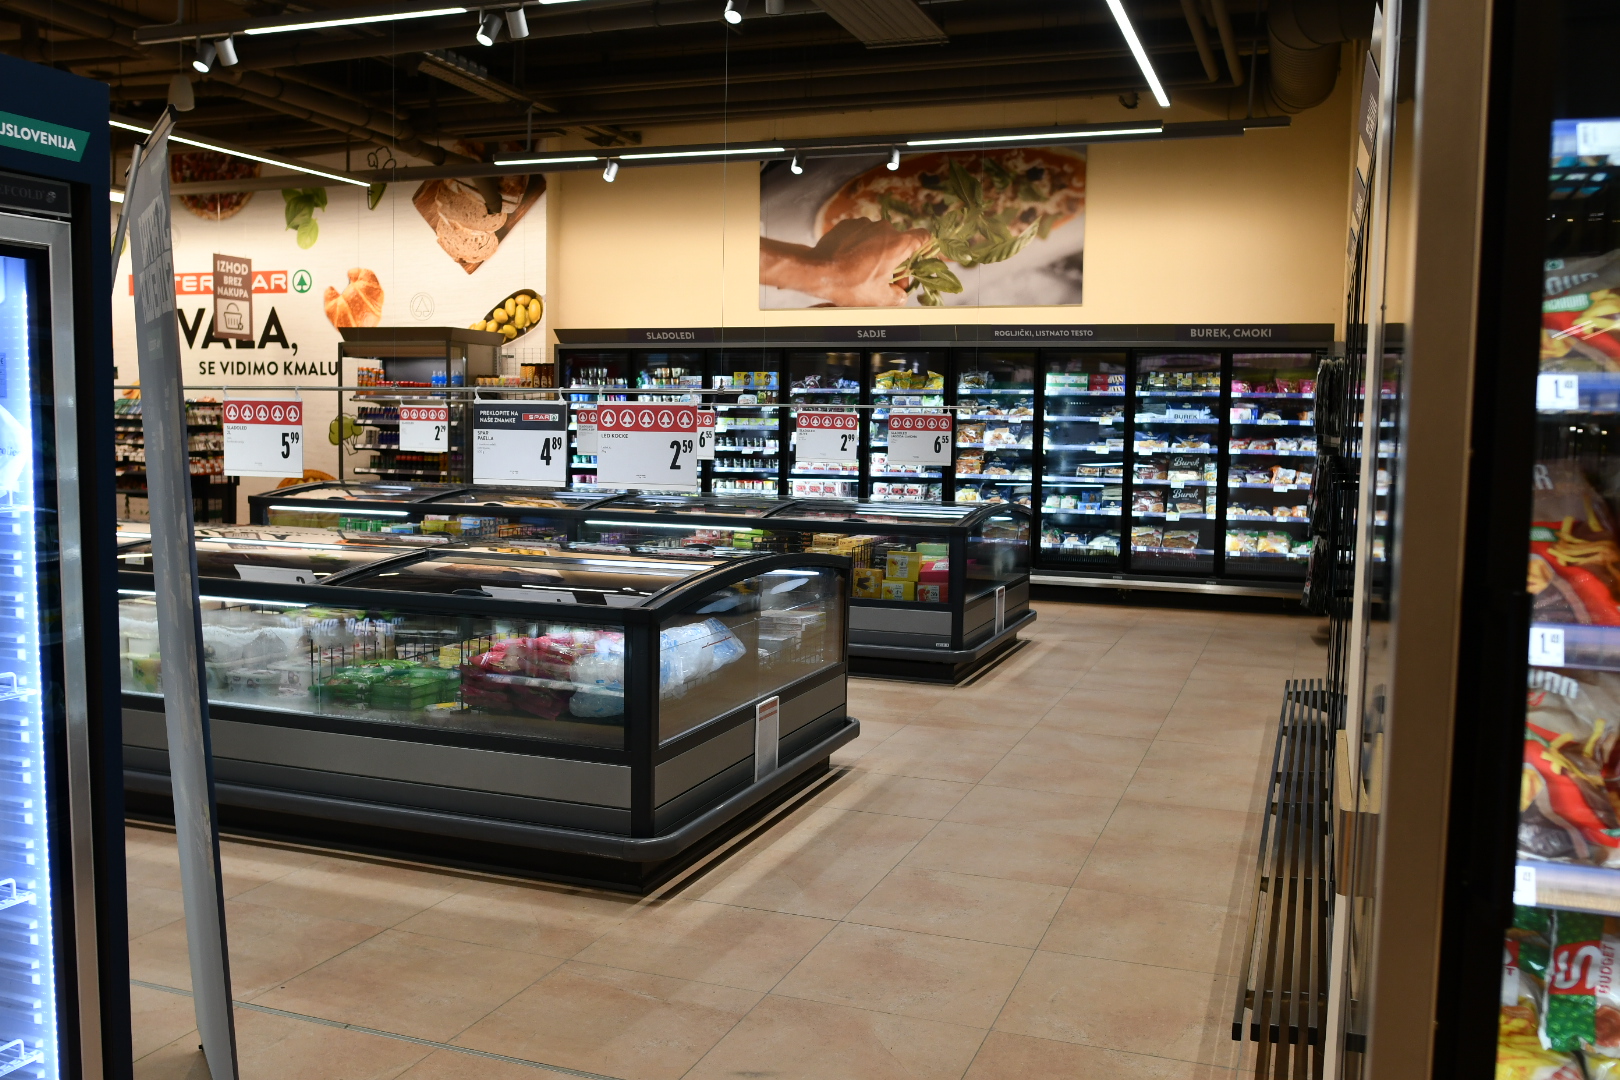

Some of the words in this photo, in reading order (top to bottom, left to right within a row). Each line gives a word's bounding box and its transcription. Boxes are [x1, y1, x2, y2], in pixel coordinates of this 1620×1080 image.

[216, 260, 249, 275] IZHOD
[223, 275, 243, 287] BREZ
[217, 286, 249, 299] NAKUPA
[646, 331, 695, 340] SLADOLEDI
[857, 329, 887, 338] SADJE
[994, 328, 1034, 338] ROGLJIČKI,
[1035, 329, 1070, 337] LISTNATO
[1071, 329, 1094, 337] TESTO
[1190, 328, 1231, 340] BUREK,
[1233, 328, 1272, 338] CMOKI
[199, 361, 216, 376] SE
[219, 361, 279, 376] VIDIMO
[283, 361, 339, 376] KMALU
[1173, 456, 1200, 467] Burek
[1172, 488, 1199, 499] Burek
[1598, 943, 1616, 995] BUDGET
